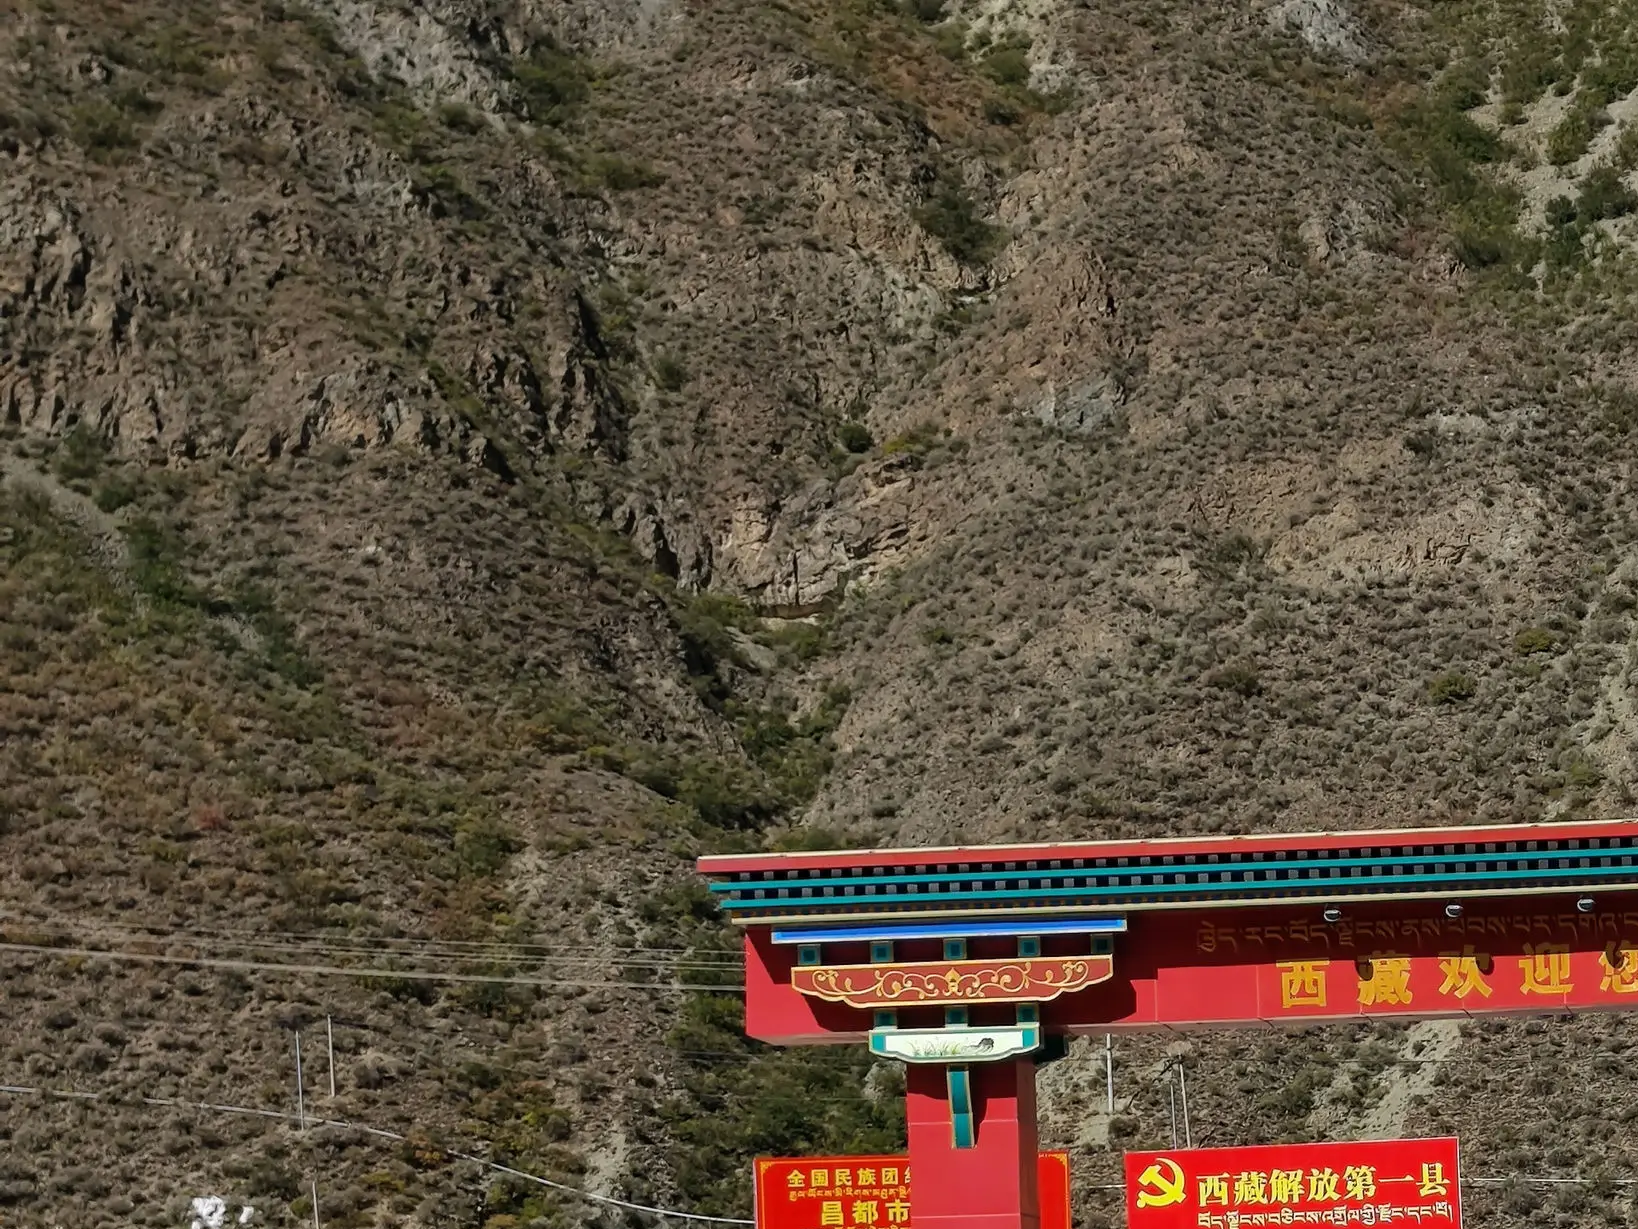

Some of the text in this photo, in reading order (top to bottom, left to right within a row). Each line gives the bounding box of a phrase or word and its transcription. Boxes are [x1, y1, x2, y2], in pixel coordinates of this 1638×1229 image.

[1195, 1161, 1451, 1208] 西藏解放第一县
[820, 1198, 911, 1226] 昌都市
